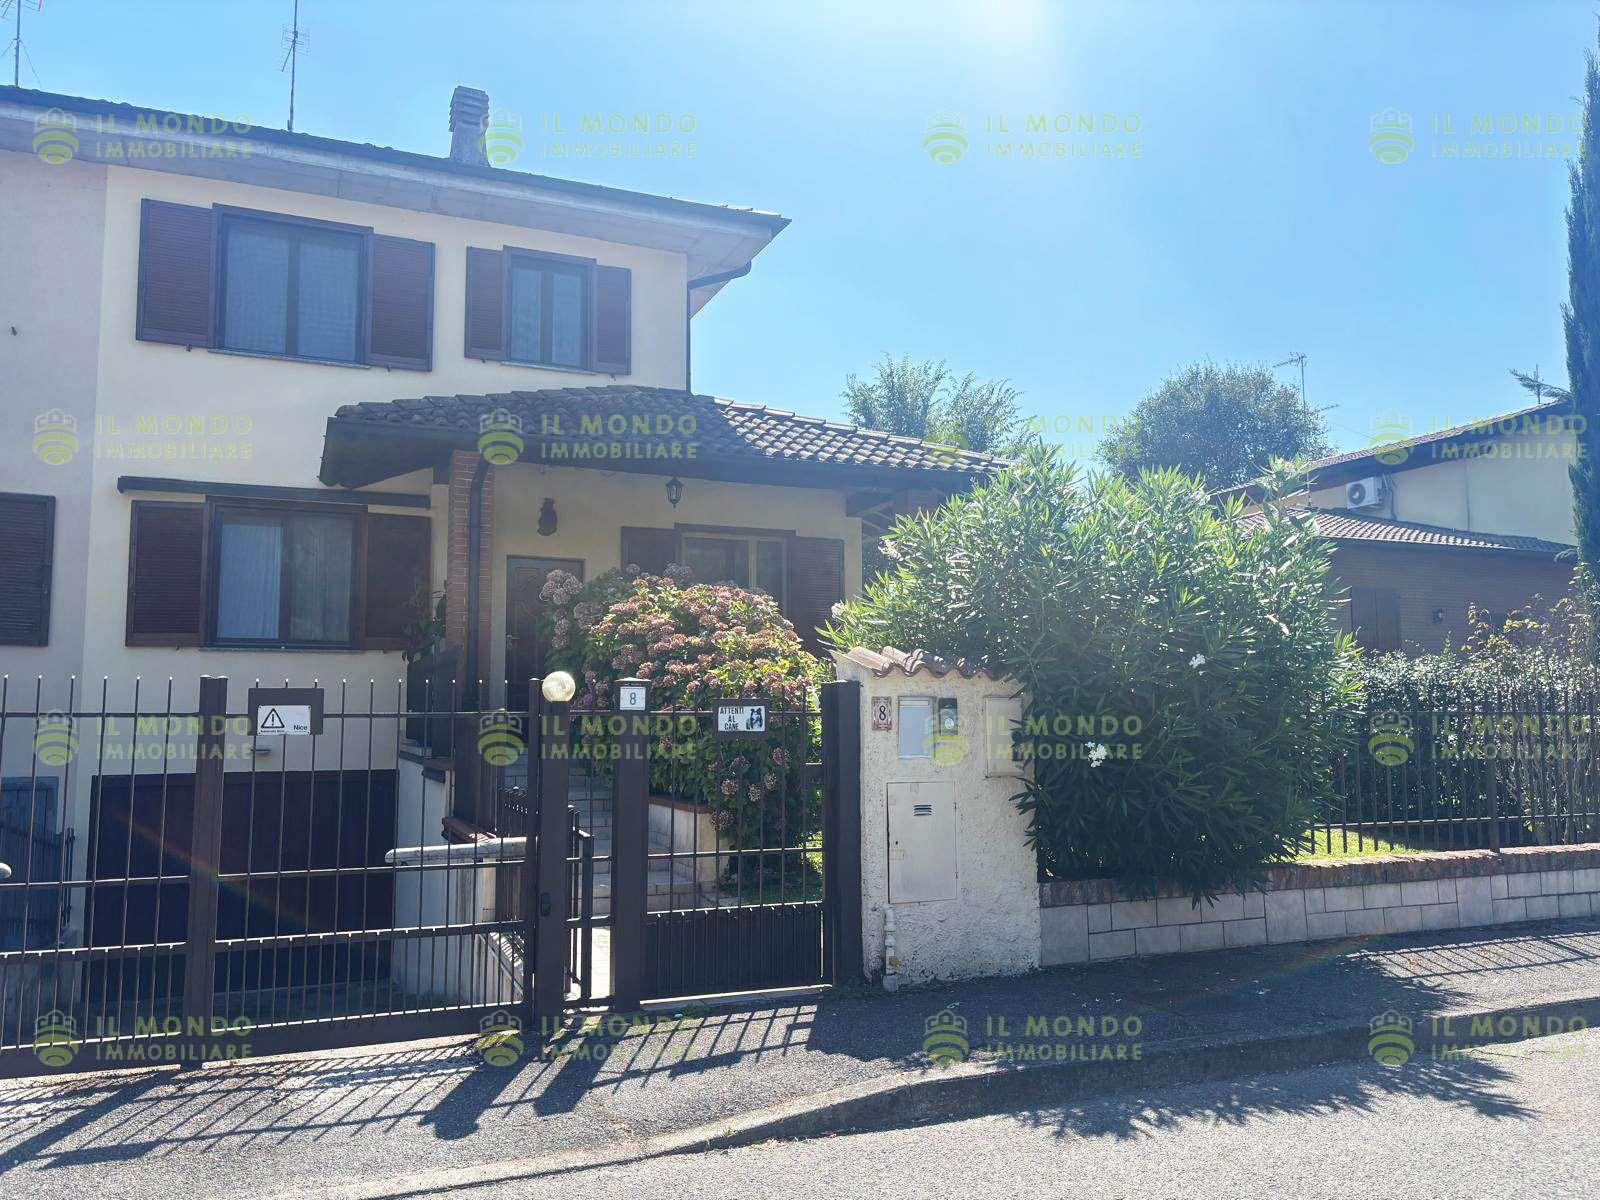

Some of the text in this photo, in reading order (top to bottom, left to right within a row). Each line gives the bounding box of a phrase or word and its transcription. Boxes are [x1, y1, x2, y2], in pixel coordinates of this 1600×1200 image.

[629, 692, 637, 705] 8
[719, 706, 744, 715] ATTENTI
[879, 705, 887, 721] 8
[728, 715, 736, 723] AL
